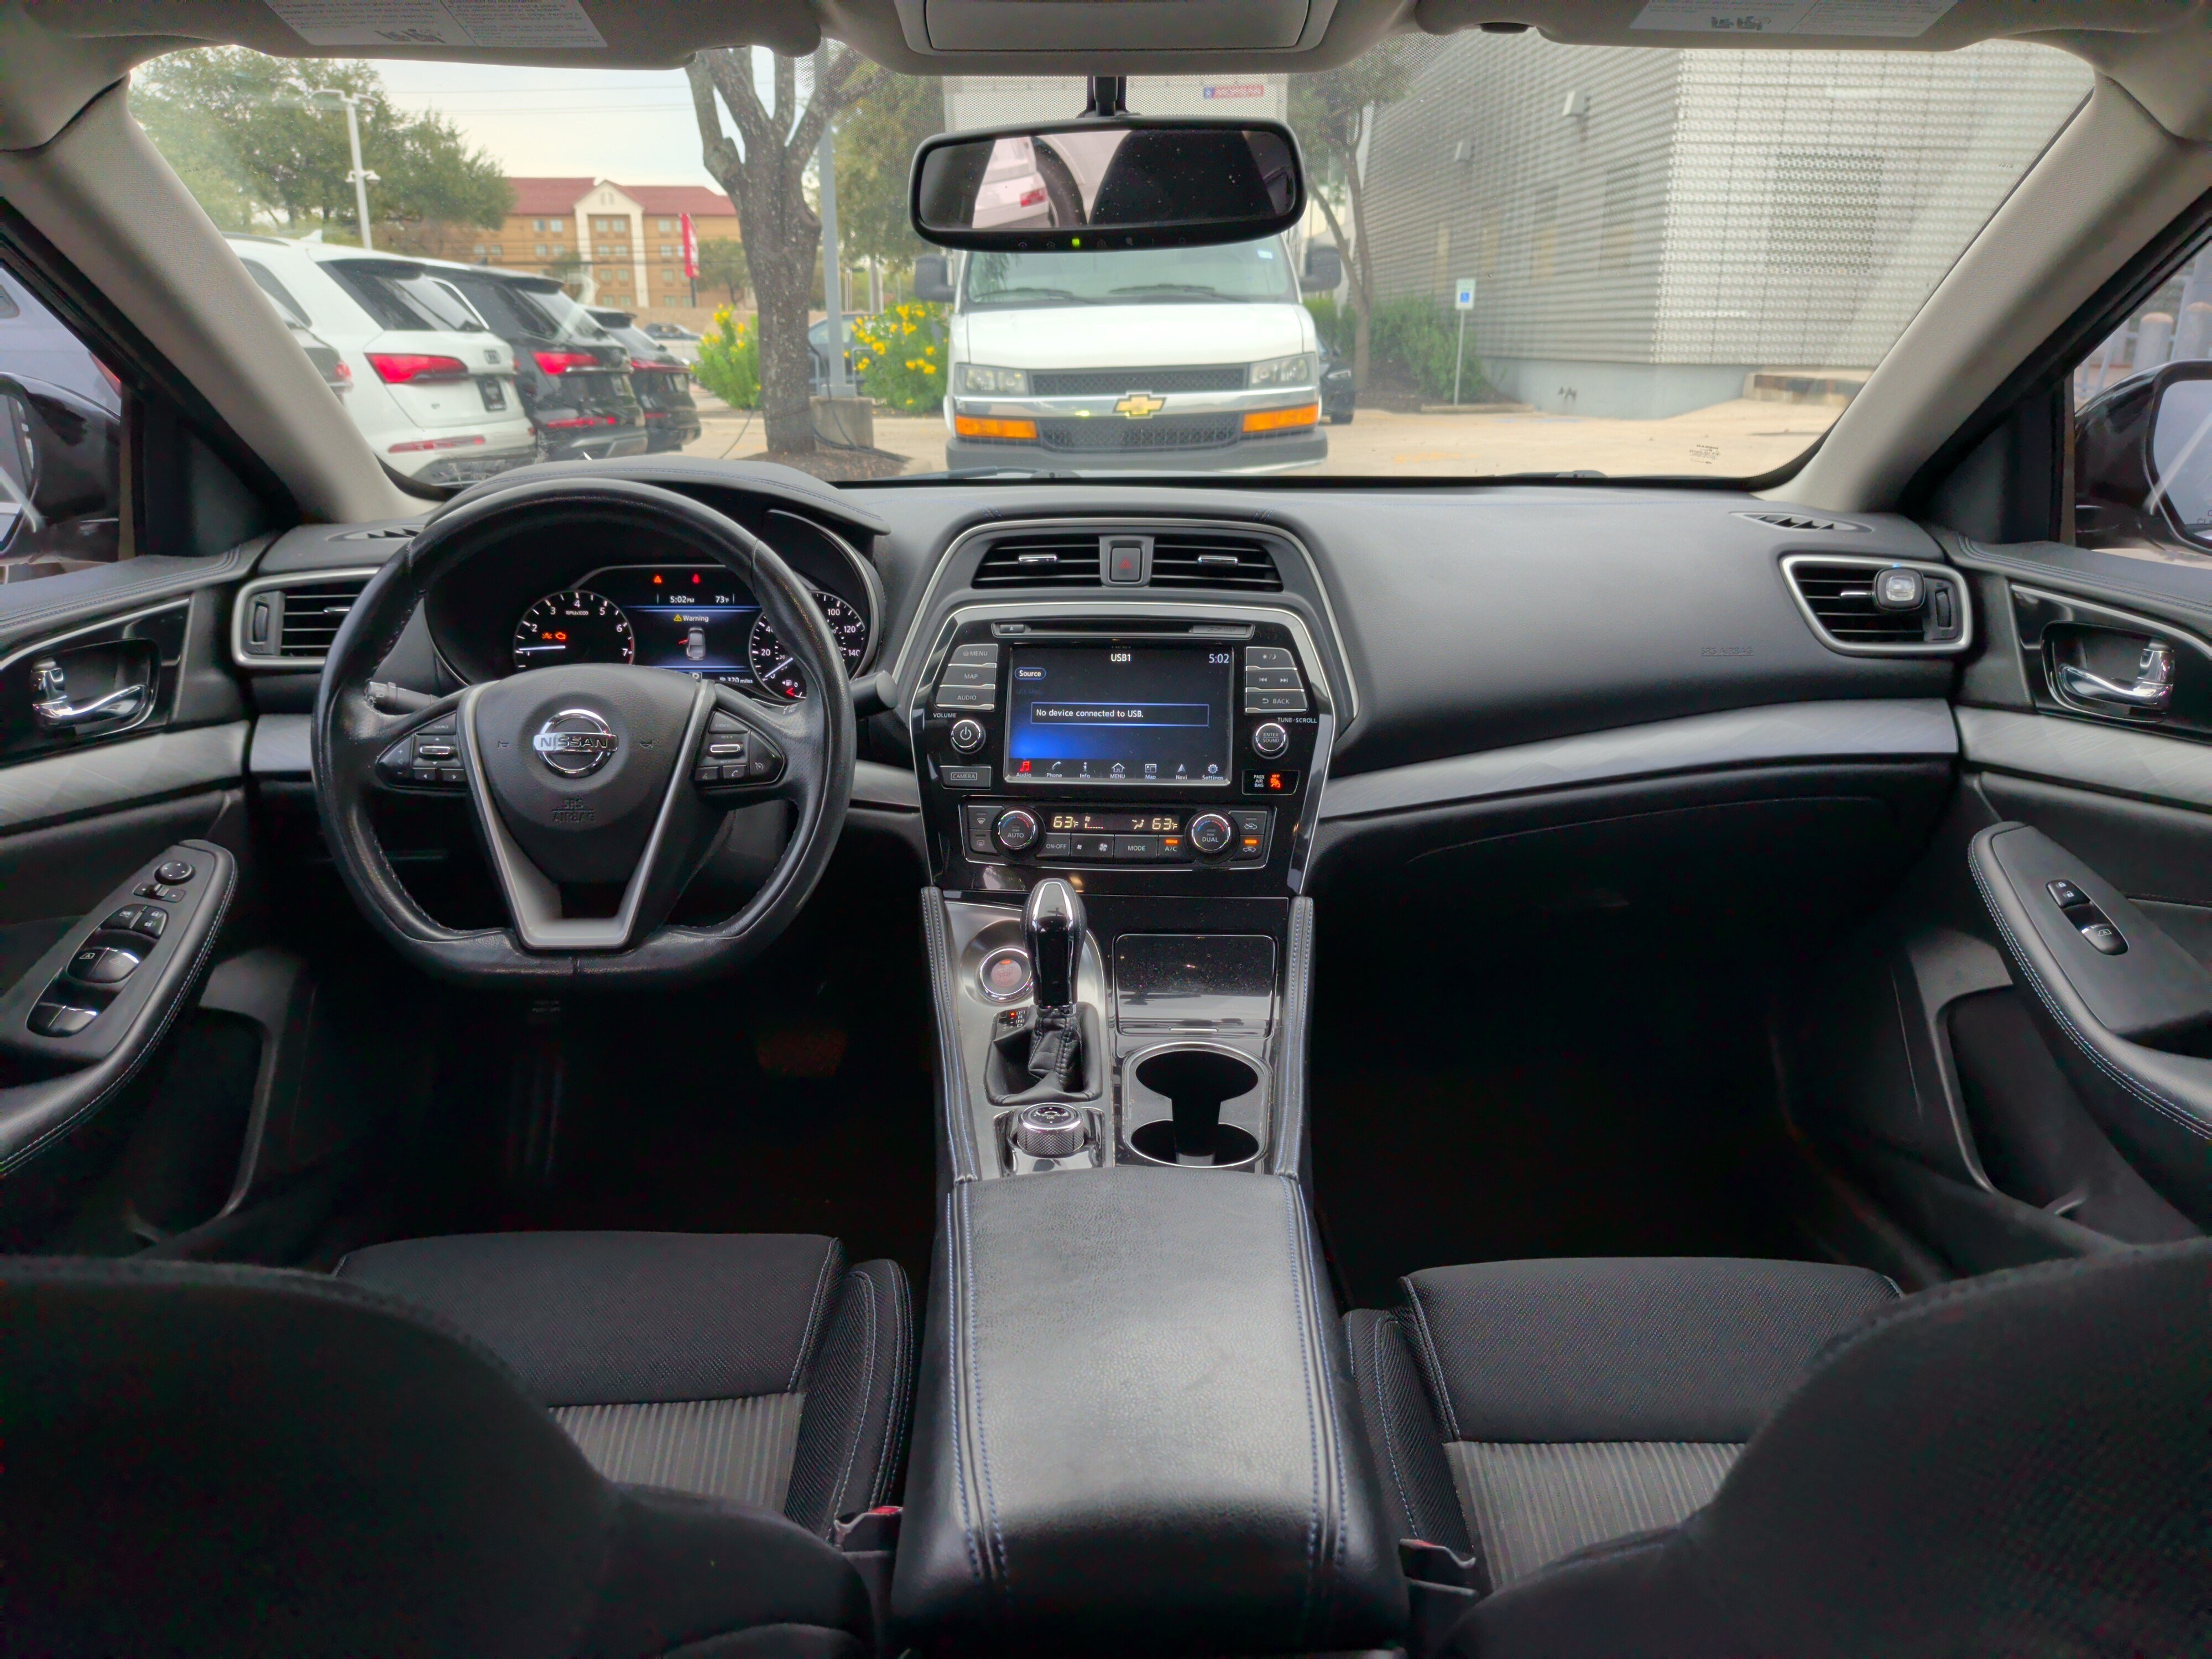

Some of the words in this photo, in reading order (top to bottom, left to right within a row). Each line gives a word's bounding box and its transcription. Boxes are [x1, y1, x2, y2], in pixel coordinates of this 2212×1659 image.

[549, 607, 556, 615] 3
[599, 607, 606, 615] 5
[531, 624, 538, 632] 2
[616, 624, 623, 632] 6
[621, 648, 628, 656] 7
[1110, 654, 1131, 662] USB1
[1208, 654, 1229, 664] 5:02
[1048, 708, 1073, 717] device
[540, 737, 608, 748] NISSAN
